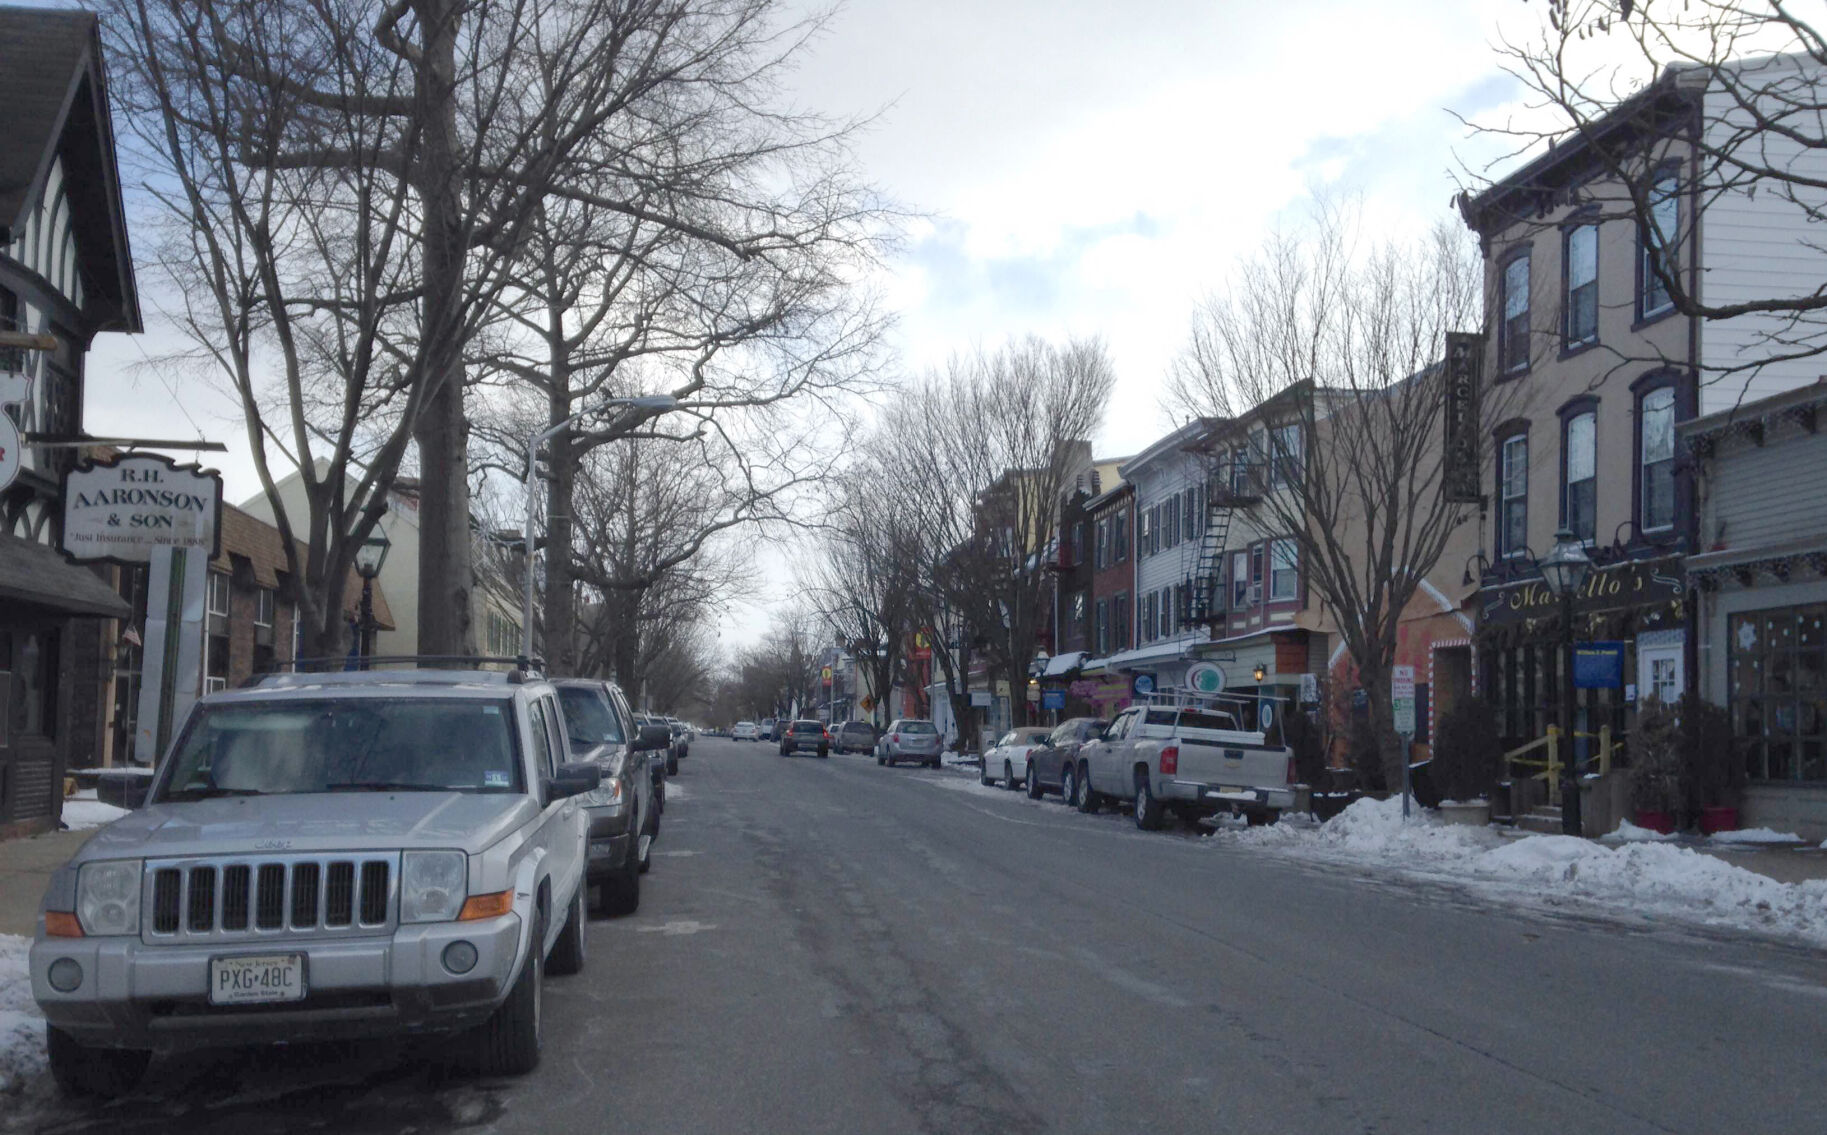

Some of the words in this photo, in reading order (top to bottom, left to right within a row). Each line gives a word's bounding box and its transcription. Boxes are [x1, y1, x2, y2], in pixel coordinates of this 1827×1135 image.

[119, 468, 164, 483] R.H.
[73, 488, 207, 513] AARONSON
[107, 513, 121, 527] &
[129, 513, 173, 528] SON
[1510, 566, 1643, 610] Maello's
